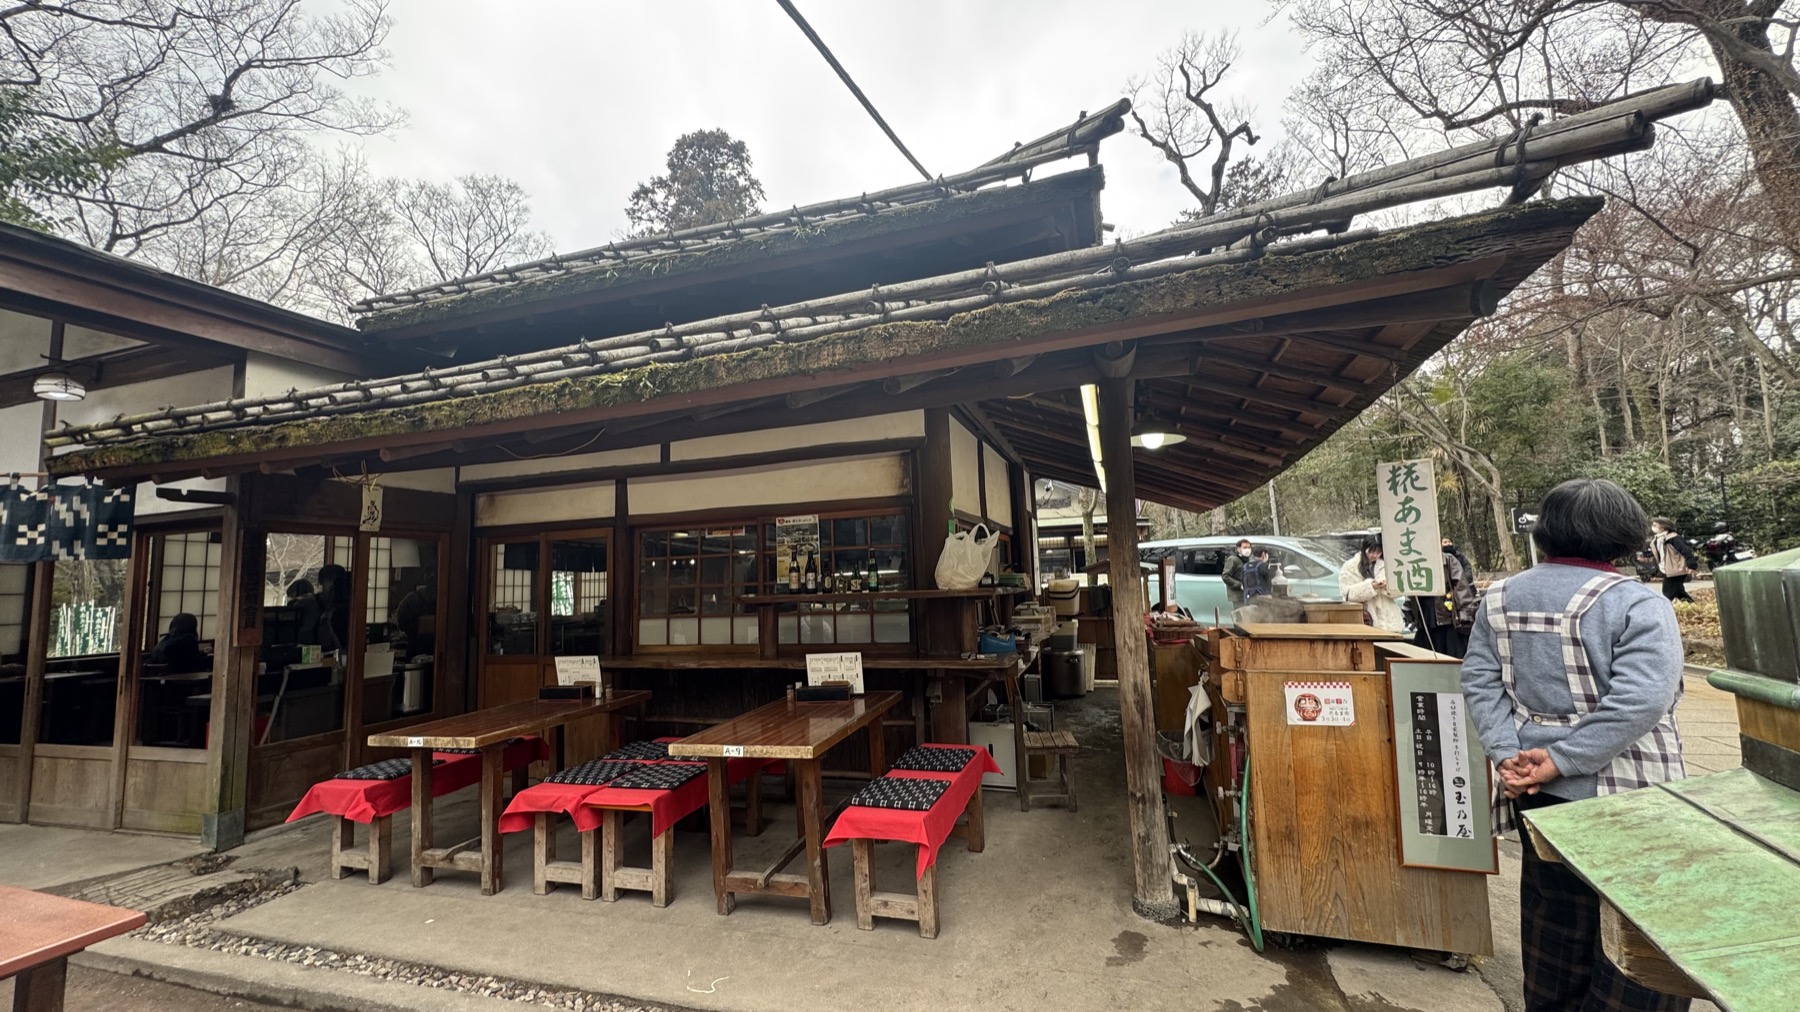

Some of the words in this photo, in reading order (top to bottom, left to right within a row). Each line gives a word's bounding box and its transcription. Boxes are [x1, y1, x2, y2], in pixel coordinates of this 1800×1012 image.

[1386, 462, 1433, 593] 糀あま酒
[1416, 695, 1426, 721] 営業時間
[1425, 729, 1432, 741] 平日
[724, 747, 741, 756] A-9
[1455, 791, 1472, 838] 玉乃屋
